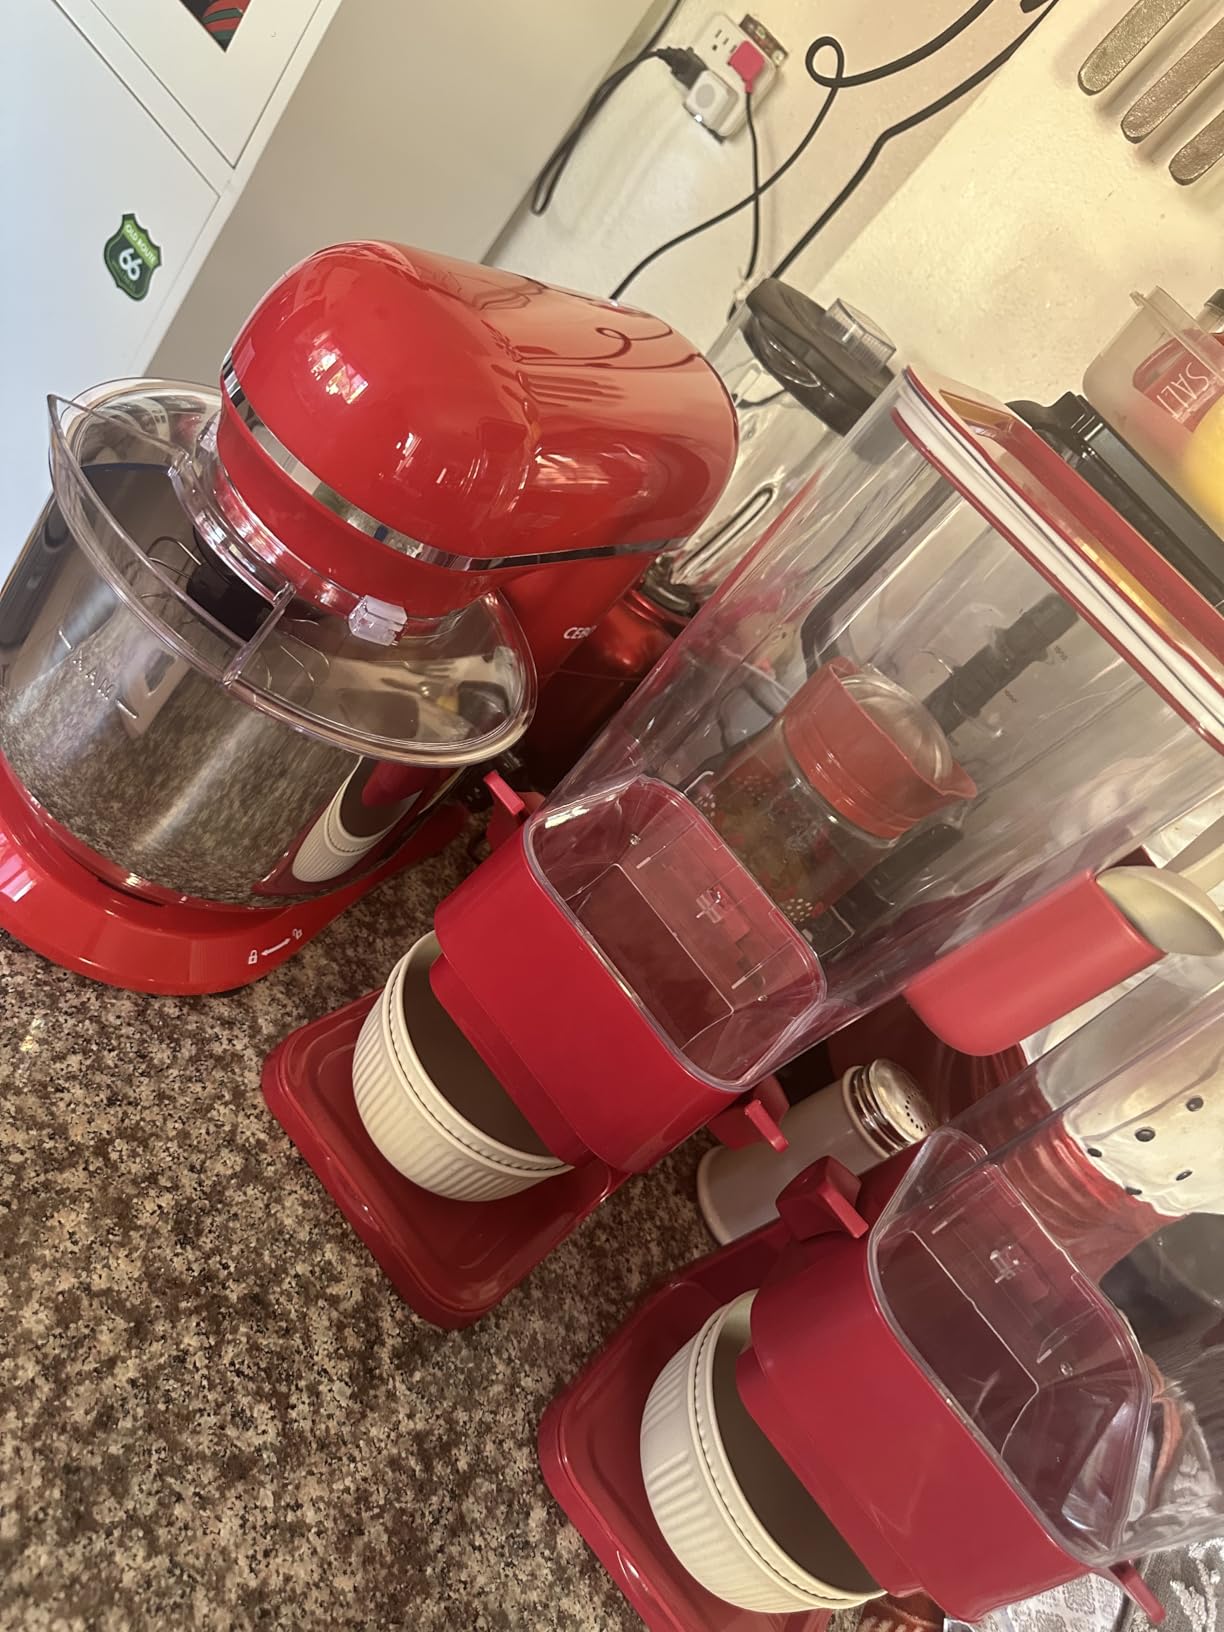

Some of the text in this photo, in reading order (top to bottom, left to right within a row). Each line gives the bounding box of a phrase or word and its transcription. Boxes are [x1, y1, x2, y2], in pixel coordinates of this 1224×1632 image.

[125, 223, 138, 241] OLD
[119, 247, 143, 281] 66
[1156, 361, 1209, 420] SALT
